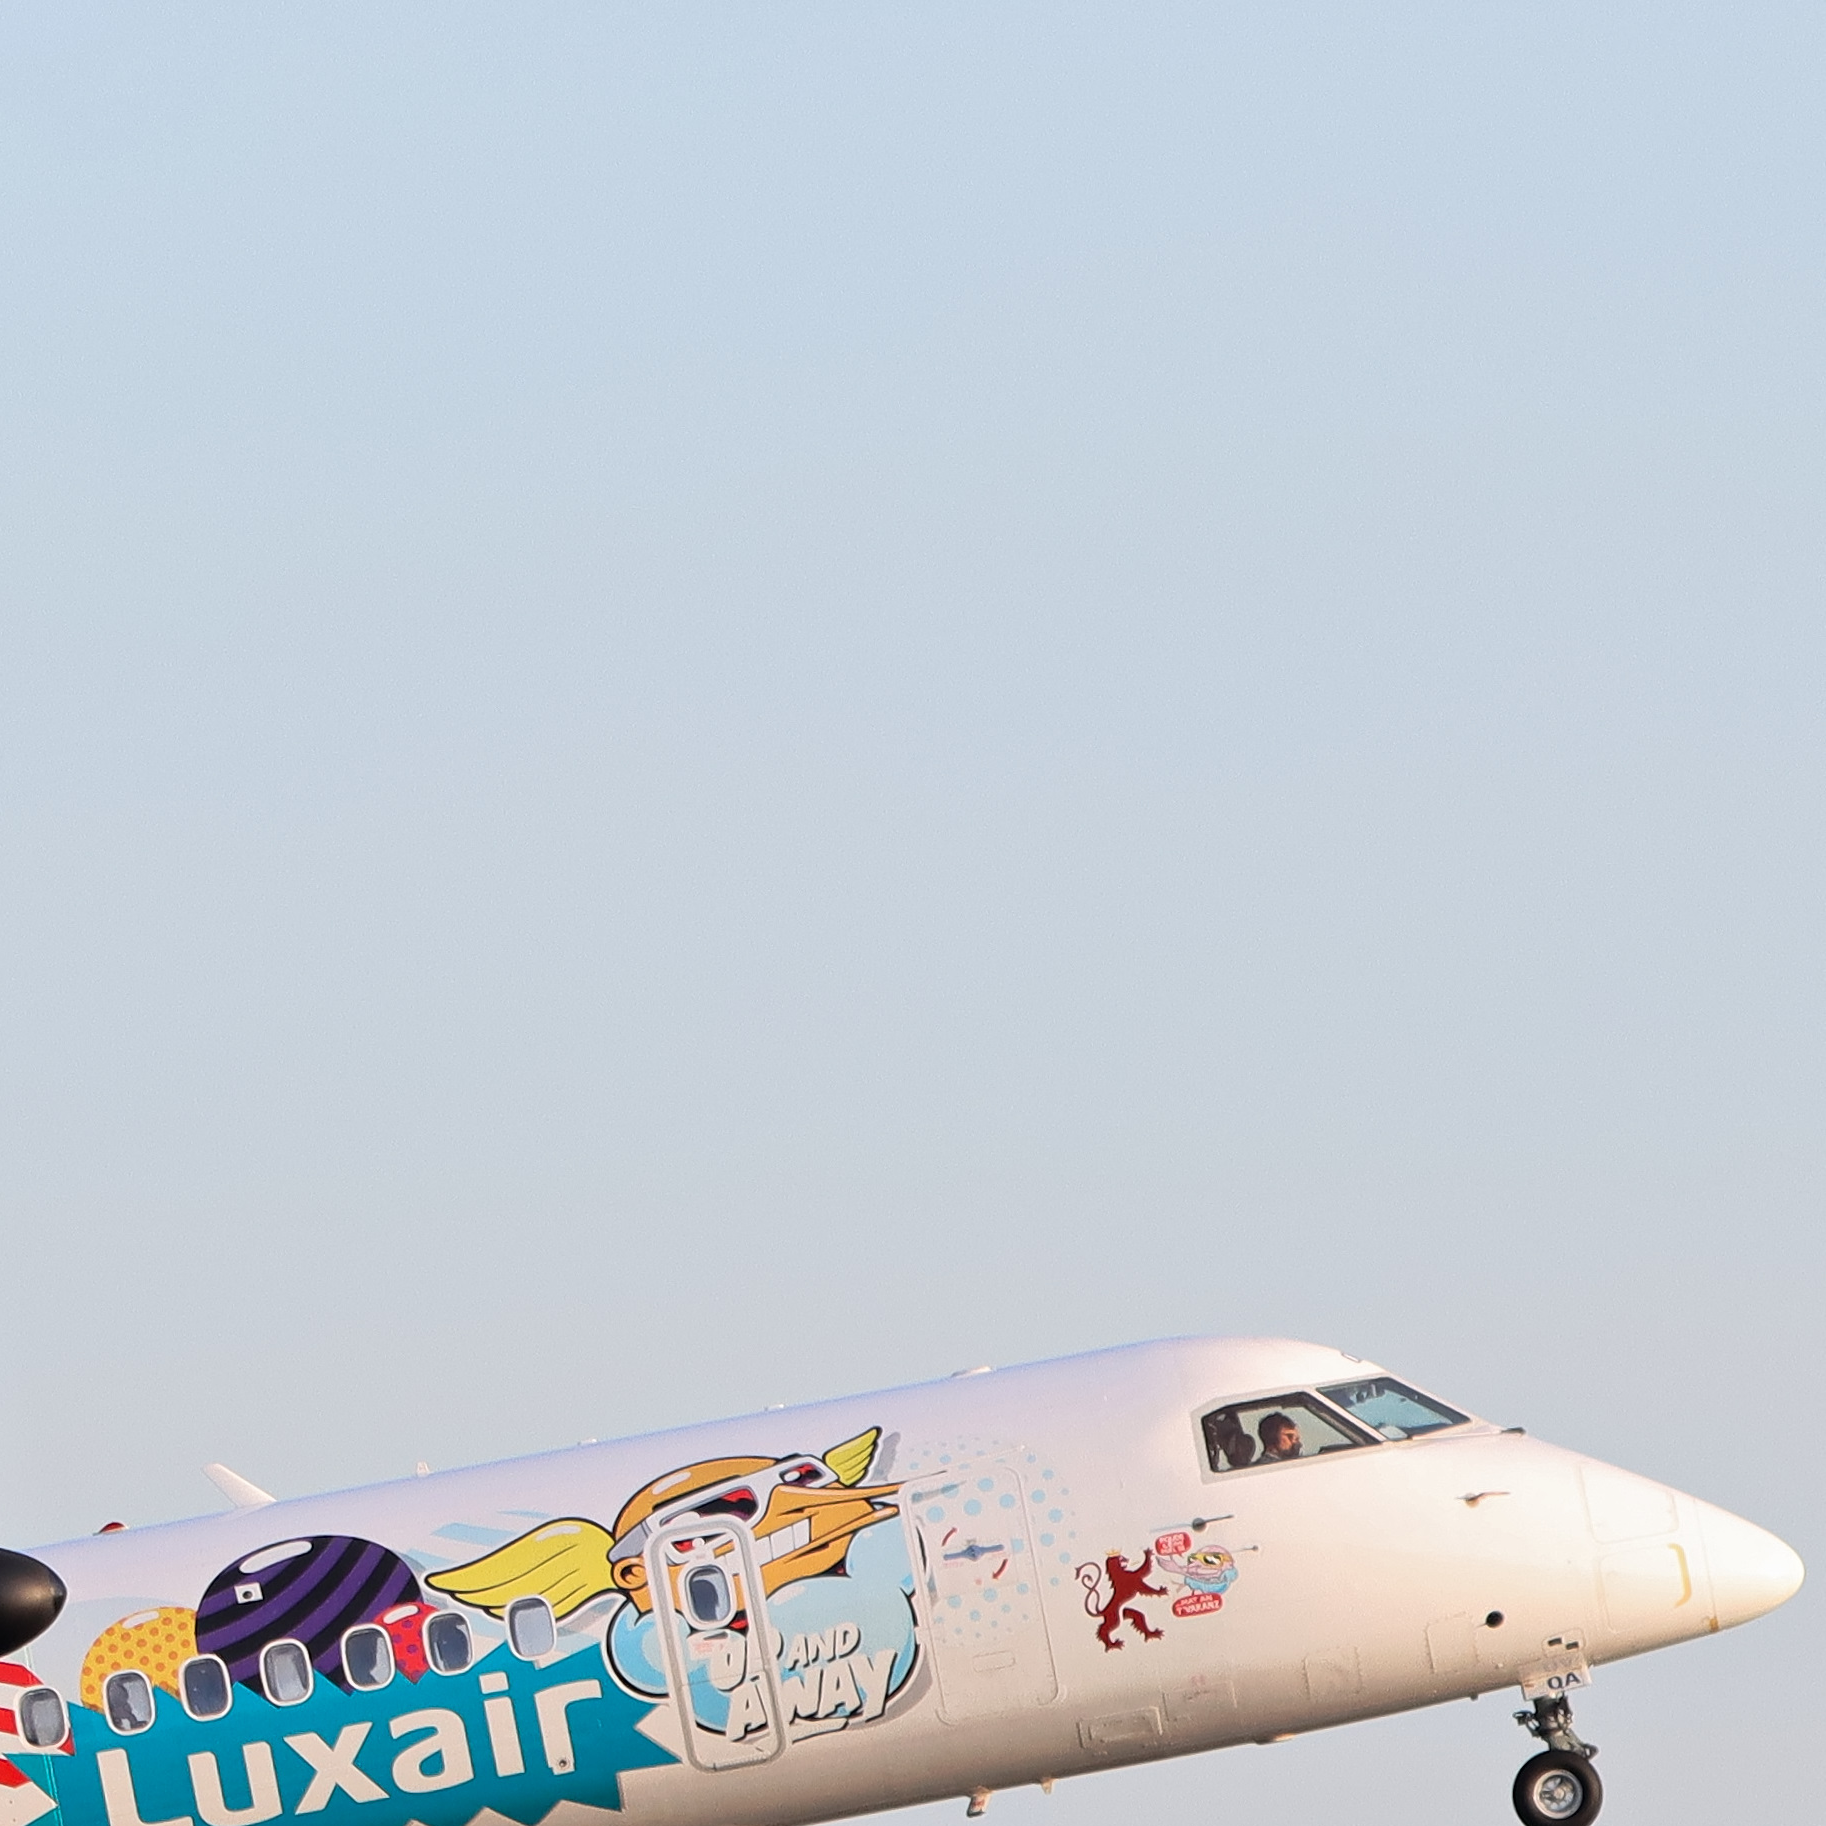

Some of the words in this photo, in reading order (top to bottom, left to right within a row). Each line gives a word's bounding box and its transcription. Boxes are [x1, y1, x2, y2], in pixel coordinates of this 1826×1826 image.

[787, 1622, 861, 1671] AND
[726, 1649, 899, 1742] AWAY
[1547, 1671, 1581, 1690] QA
